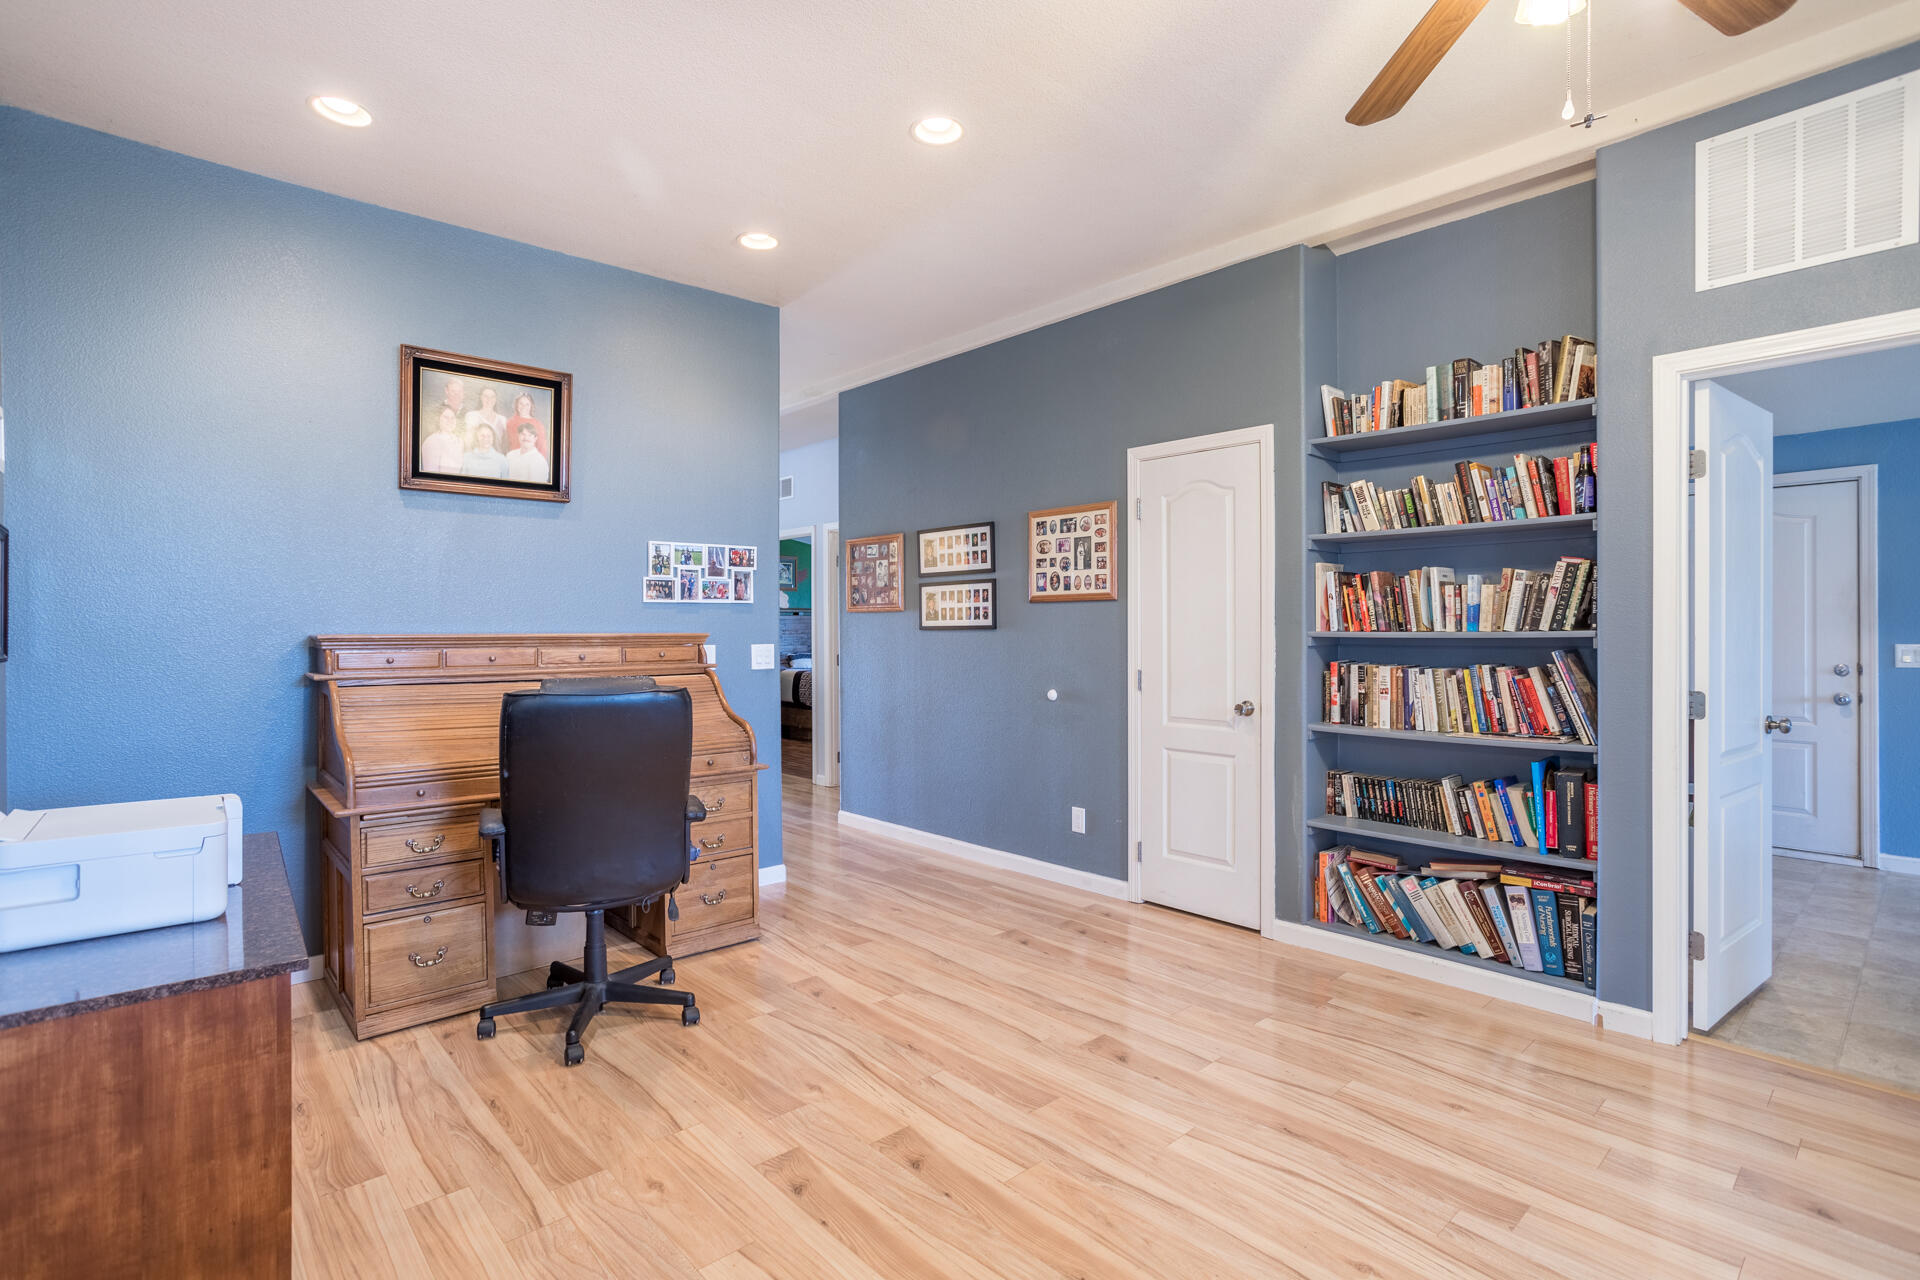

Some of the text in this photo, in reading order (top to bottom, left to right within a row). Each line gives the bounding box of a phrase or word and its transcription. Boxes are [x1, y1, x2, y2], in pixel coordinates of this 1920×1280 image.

[1561, 565, 1574, 597] CAROLE
[1554, 600, 1565, 620] KING
[1544, 906, 1556, 947] Fundamentals
